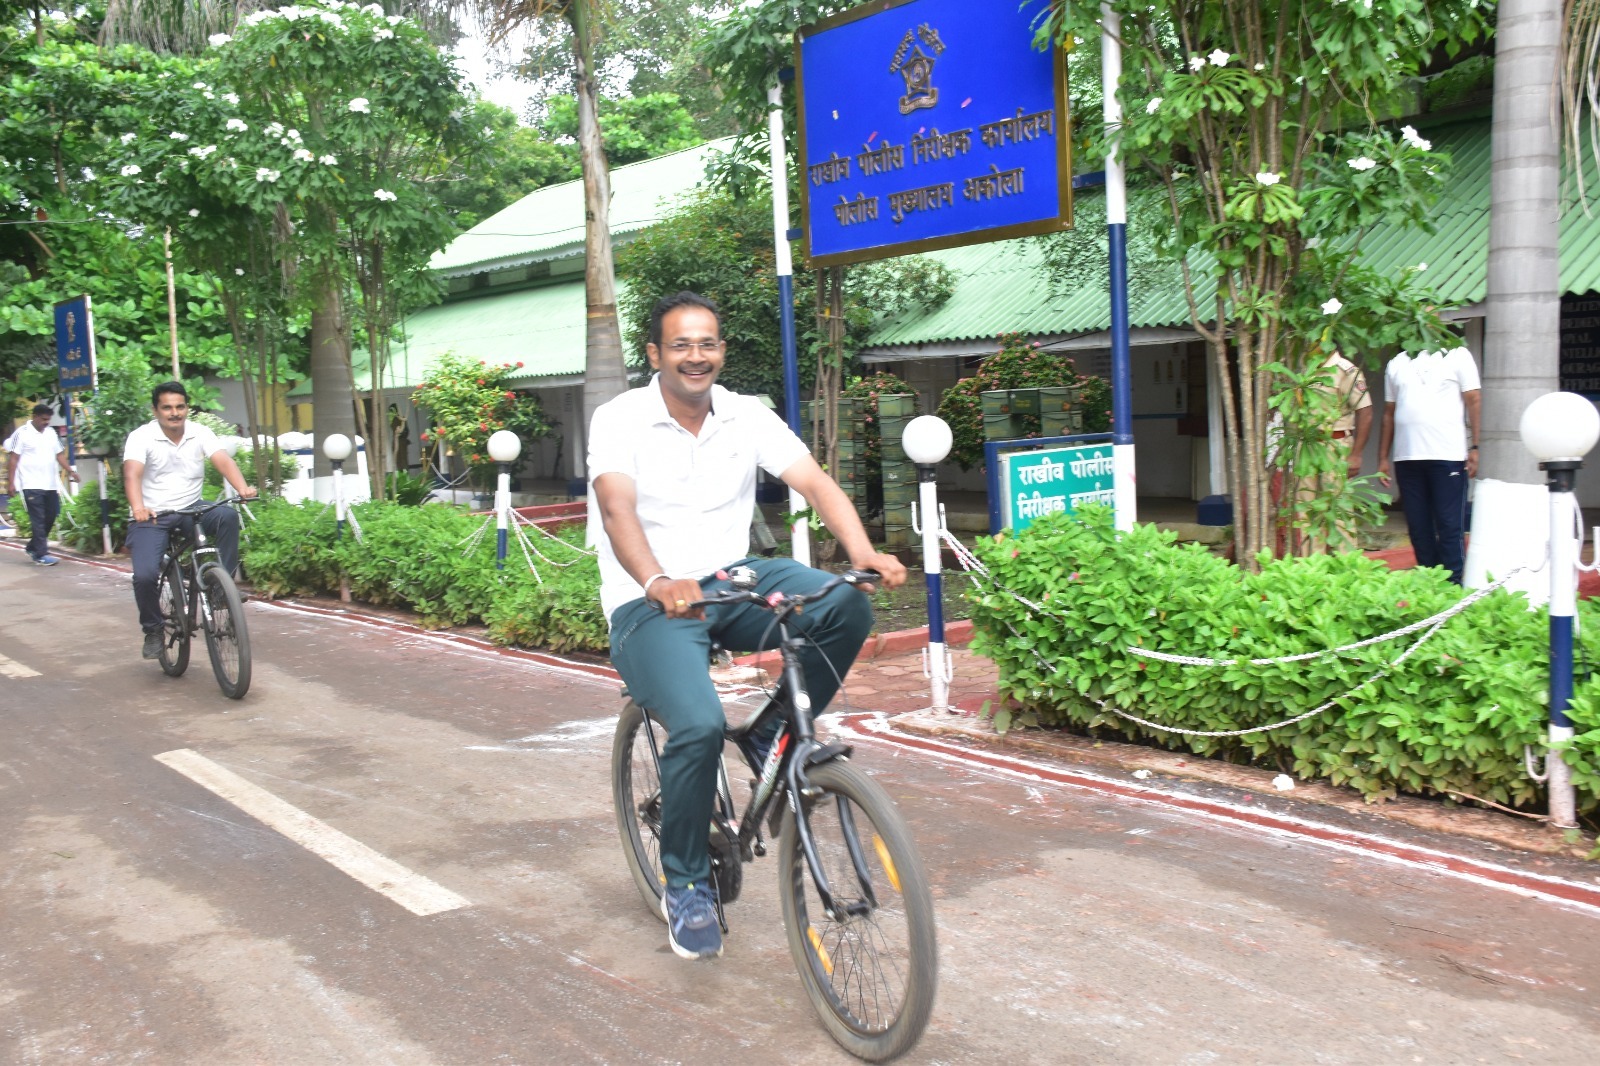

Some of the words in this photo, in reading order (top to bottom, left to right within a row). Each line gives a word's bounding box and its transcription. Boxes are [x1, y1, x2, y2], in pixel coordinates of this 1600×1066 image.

[808, 151, 851, 187] राखीव
[856, 139, 905, 177] पोलीस
[911, 127, 973, 165] निरीक्षक
[979, 107, 1054, 149] कार्यालय
[832, 191, 879, 226] पोलीस
[887, 181, 955, 223] मुख्यालय
[962, 163, 1025, 201] अकोला
[1017, 456, 1065, 486] राखीव
[1016, 490, 1067, 520] निरीक्षक
